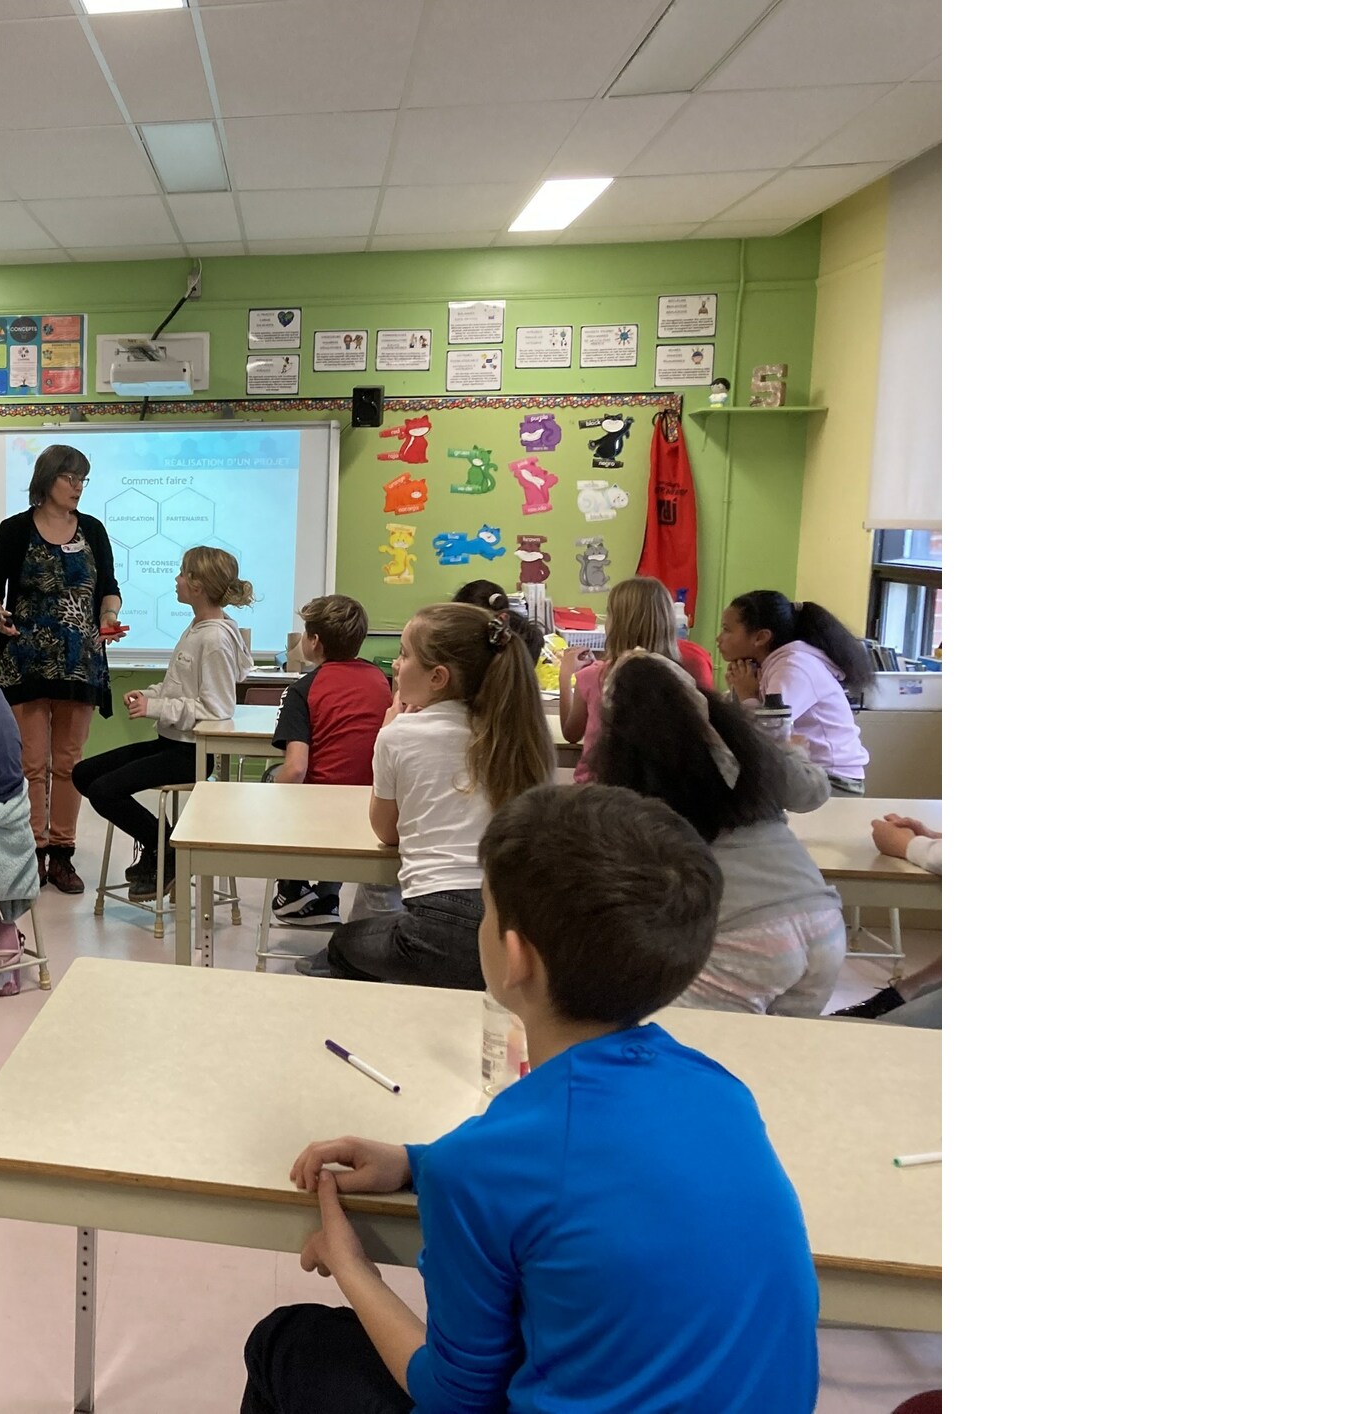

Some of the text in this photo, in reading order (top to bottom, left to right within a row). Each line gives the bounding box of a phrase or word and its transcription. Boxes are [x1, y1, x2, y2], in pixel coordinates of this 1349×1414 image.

[254, 458, 290, 466] PROJET
[122, 476, 164, 485] Comment
[166, 476, 187, 484] faire
